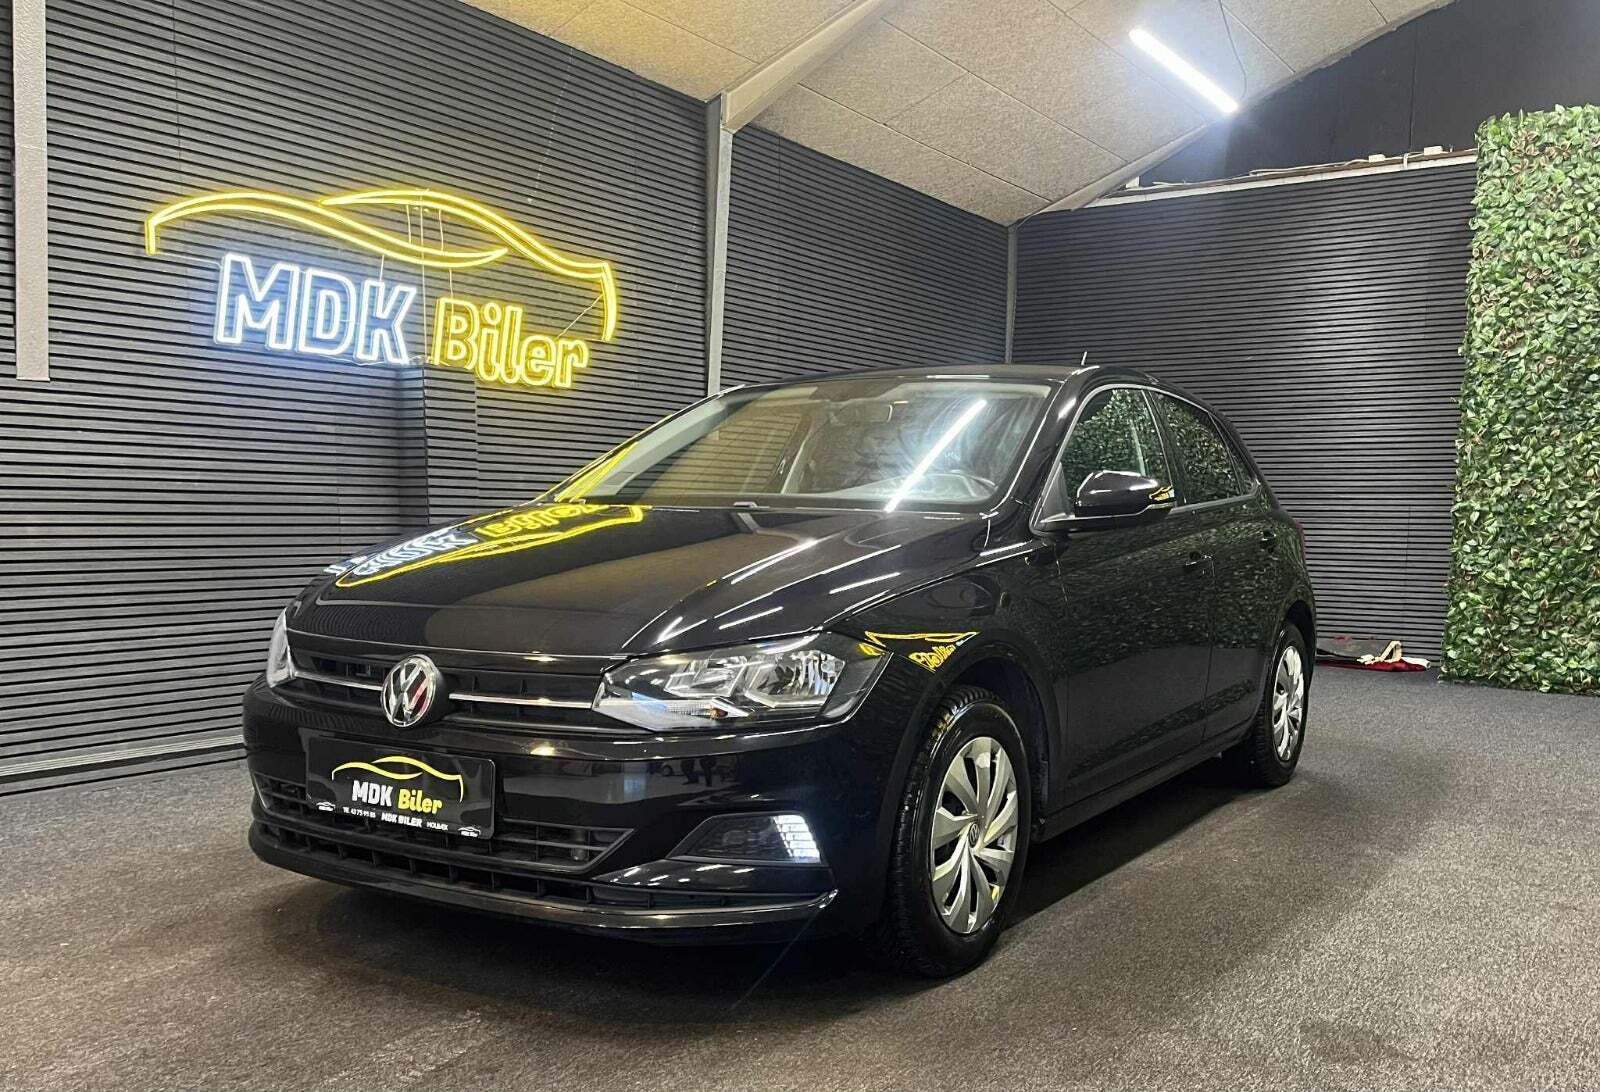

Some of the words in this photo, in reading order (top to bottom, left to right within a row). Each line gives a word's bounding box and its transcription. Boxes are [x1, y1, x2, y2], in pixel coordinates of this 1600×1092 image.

[213, 252, 418, 366] MDK
[430, 295, 591, 389] Biler
[352, 780, 393, 807] MDK
[398, 788, 443, 815] Biler
[398, 815, 422, 828] BILER
